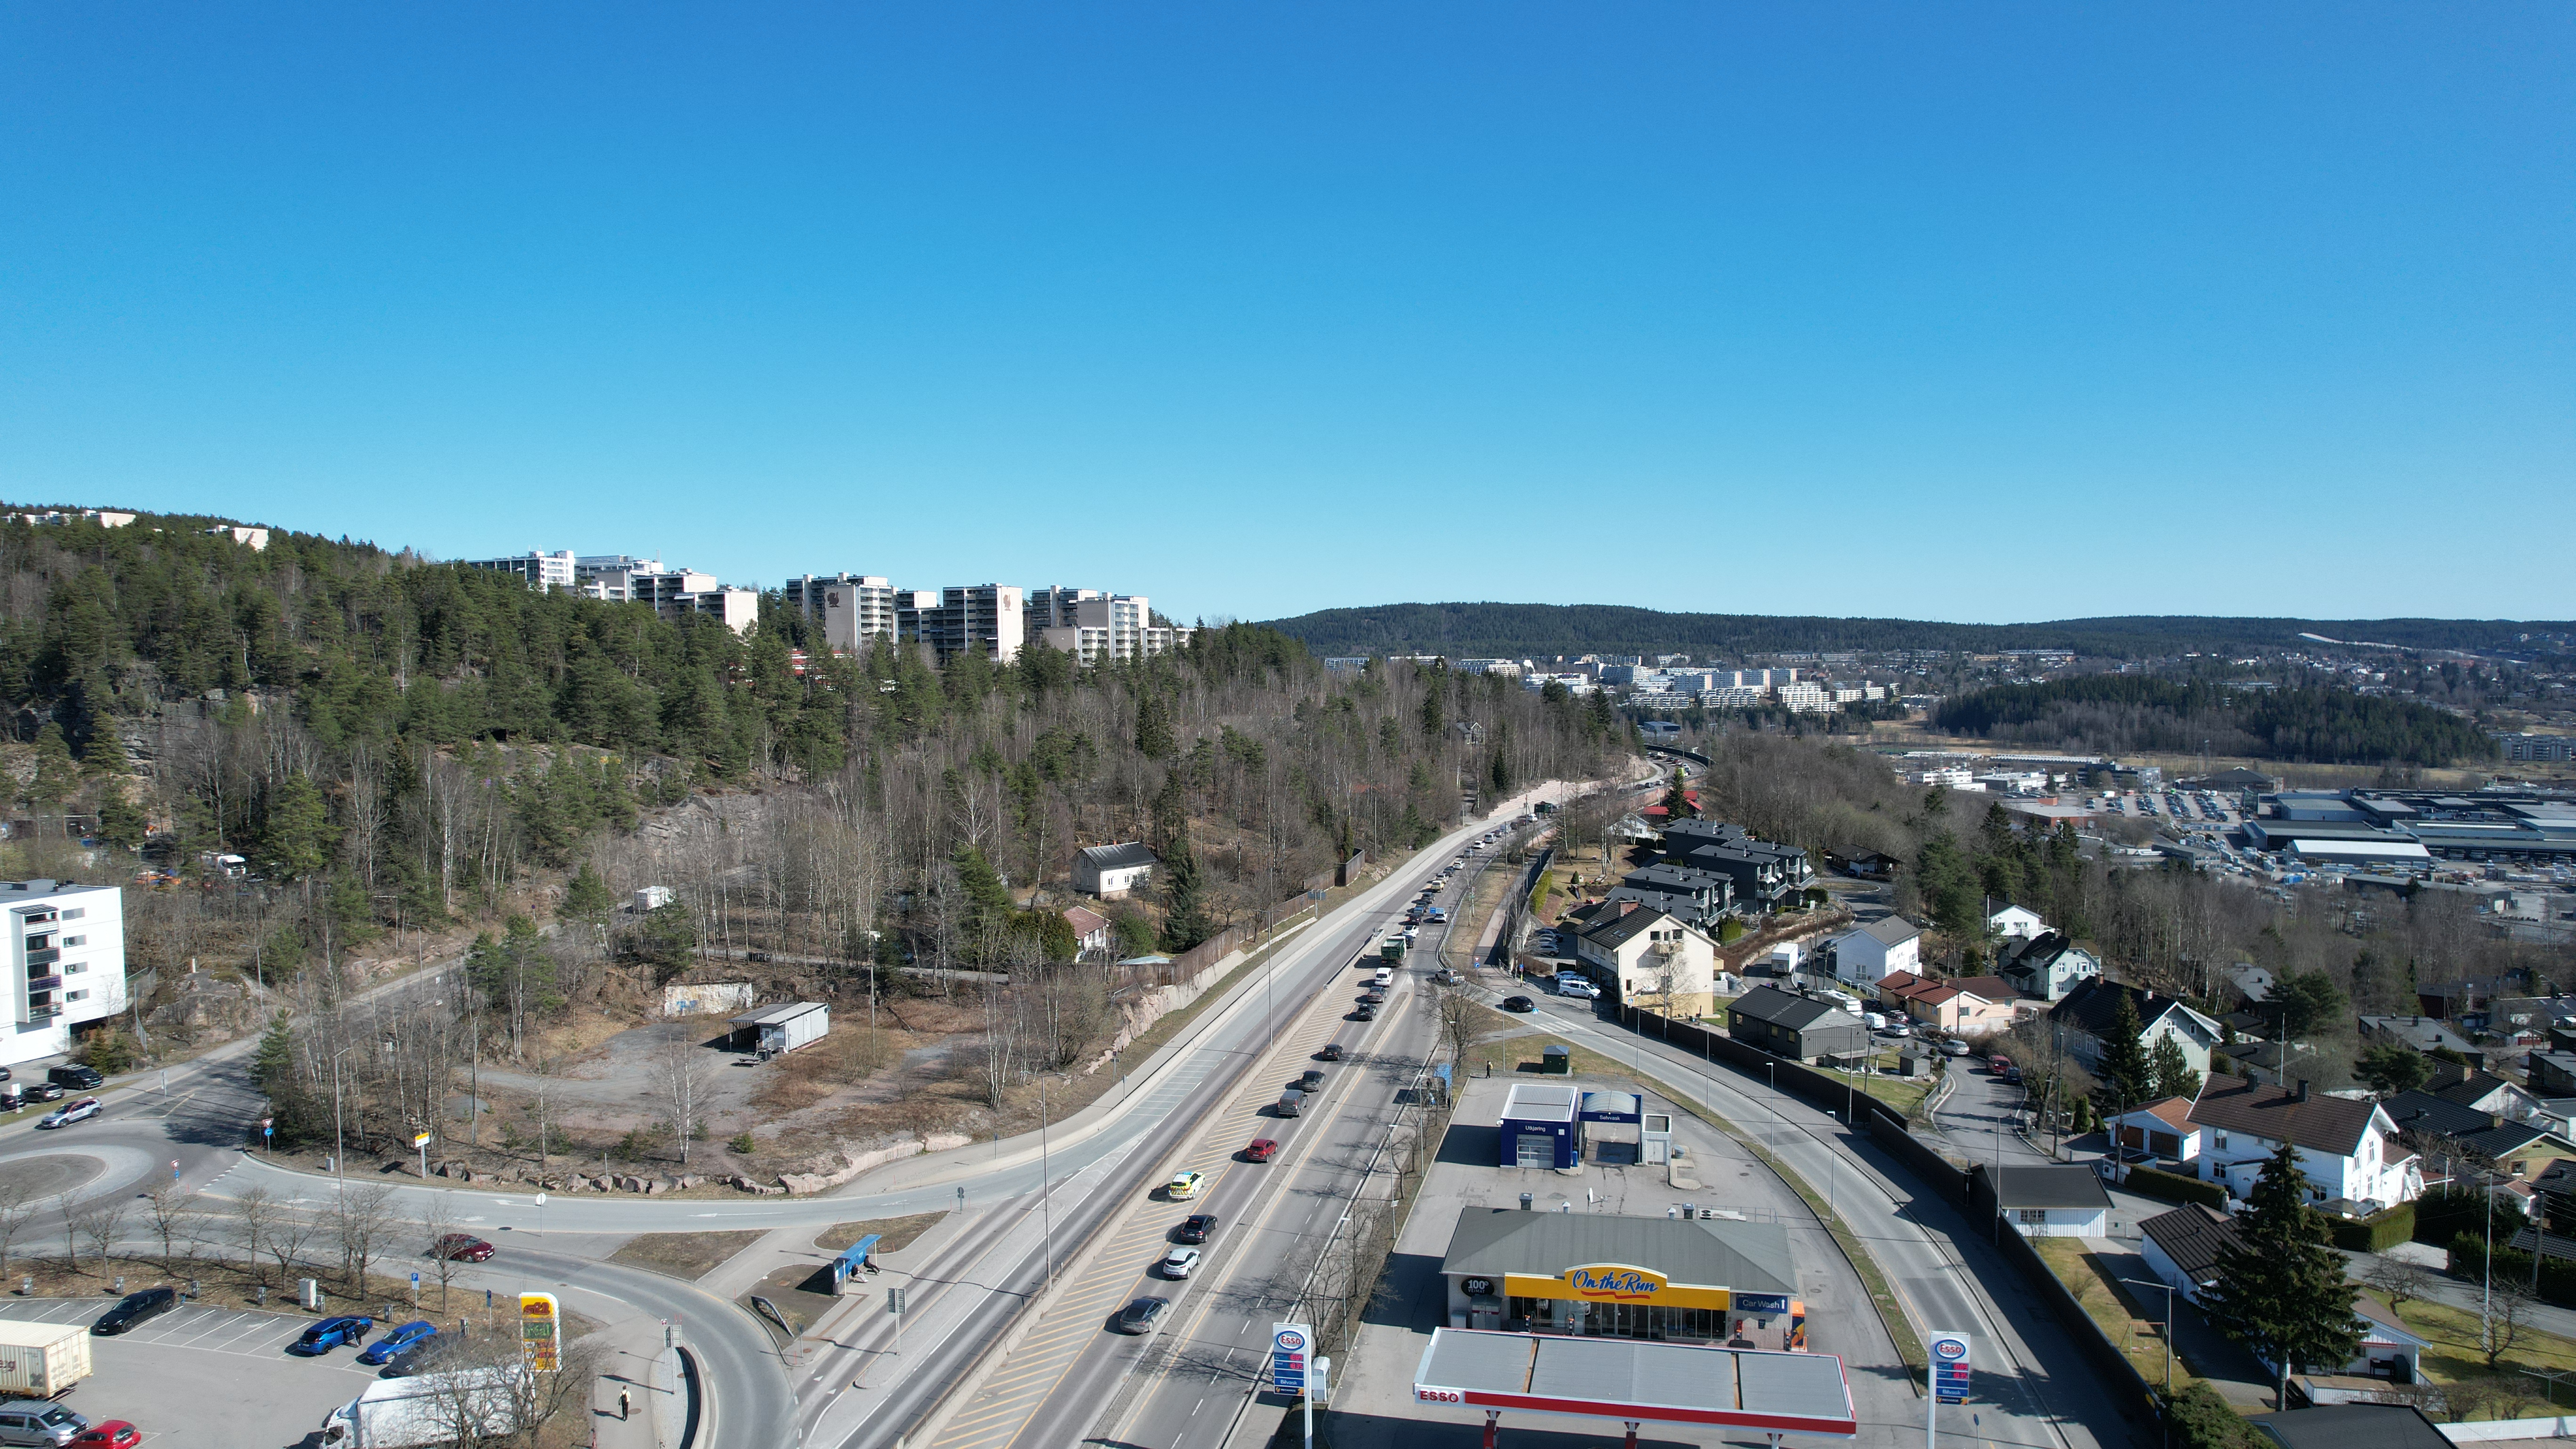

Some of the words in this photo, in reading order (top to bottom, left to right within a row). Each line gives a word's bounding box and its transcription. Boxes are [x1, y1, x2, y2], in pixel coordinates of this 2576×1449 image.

[1573, 1270, 1598, 1288] On
[1599, 1272, 1624, 1290] the
[1620, 1272, 1659, 1294] Run
[1420, 1391, 1459, 1403] ESSO
